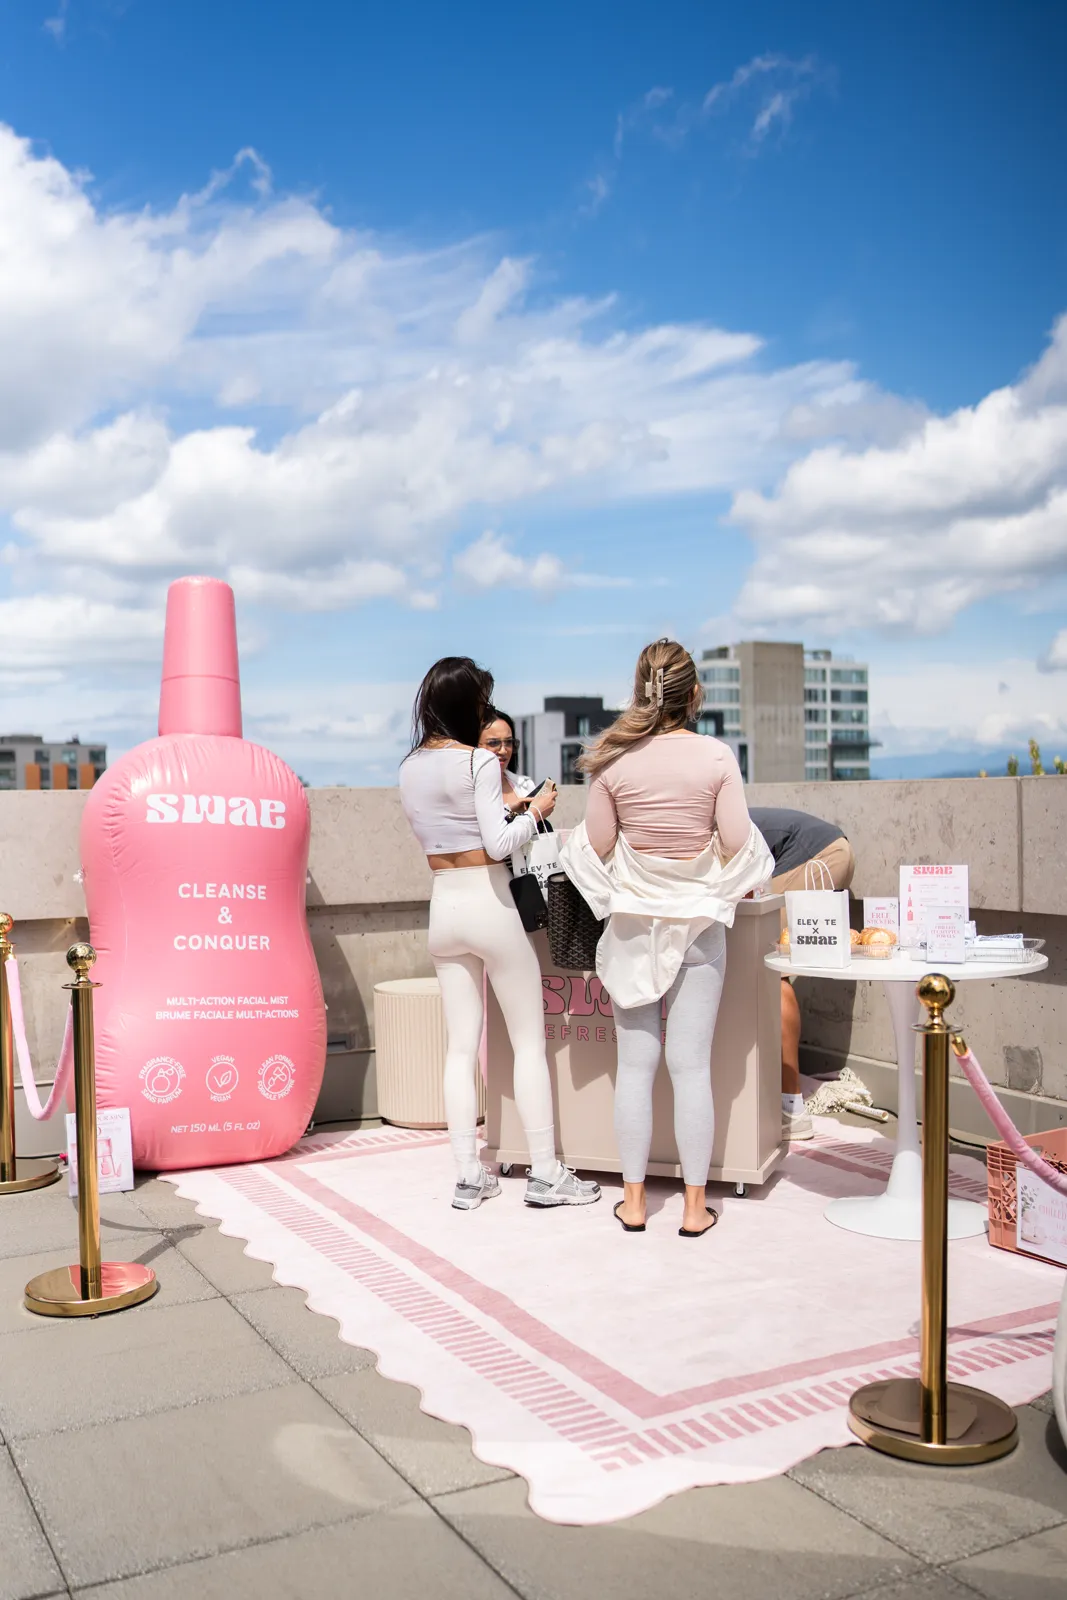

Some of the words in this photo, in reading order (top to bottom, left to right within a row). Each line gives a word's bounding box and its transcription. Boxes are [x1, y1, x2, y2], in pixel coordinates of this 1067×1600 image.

[178, 883, 267, 900] CLEANSE
[217, 906, 233, 924] &
[173, 935, 270, 951] CONQUER
[166, 996, 235, 1006] MULTI-ACTION
[237, 996, 268, 1005] FACIAL
[270, 996, 289, 1005] MIST
[155, 1010, 191, 1020] BRUME
[193, 1010, 233, 1020] FACIALE
[235, 1009, 299, 1019] MULTI-ACTIONS
[211, 1054, 235, 1063] VEGAN
[257, 1056, 274, 1076] CLEAN
[274, 1054, 297, 1074] FORMULA
[141, 1088, 157, 1103] SANS
[210, 1093, 232, 1102] VEGAN
[170, 1125, 189, 1133] NET
[189, 1123, 207, 1132] 150
[208, 1123, 221, 1132] ML
[223, 1121, 232, 1132] (5
[233, 1123, 245, 1131] FL
[246, 1120, 261, 1131] OZ)
